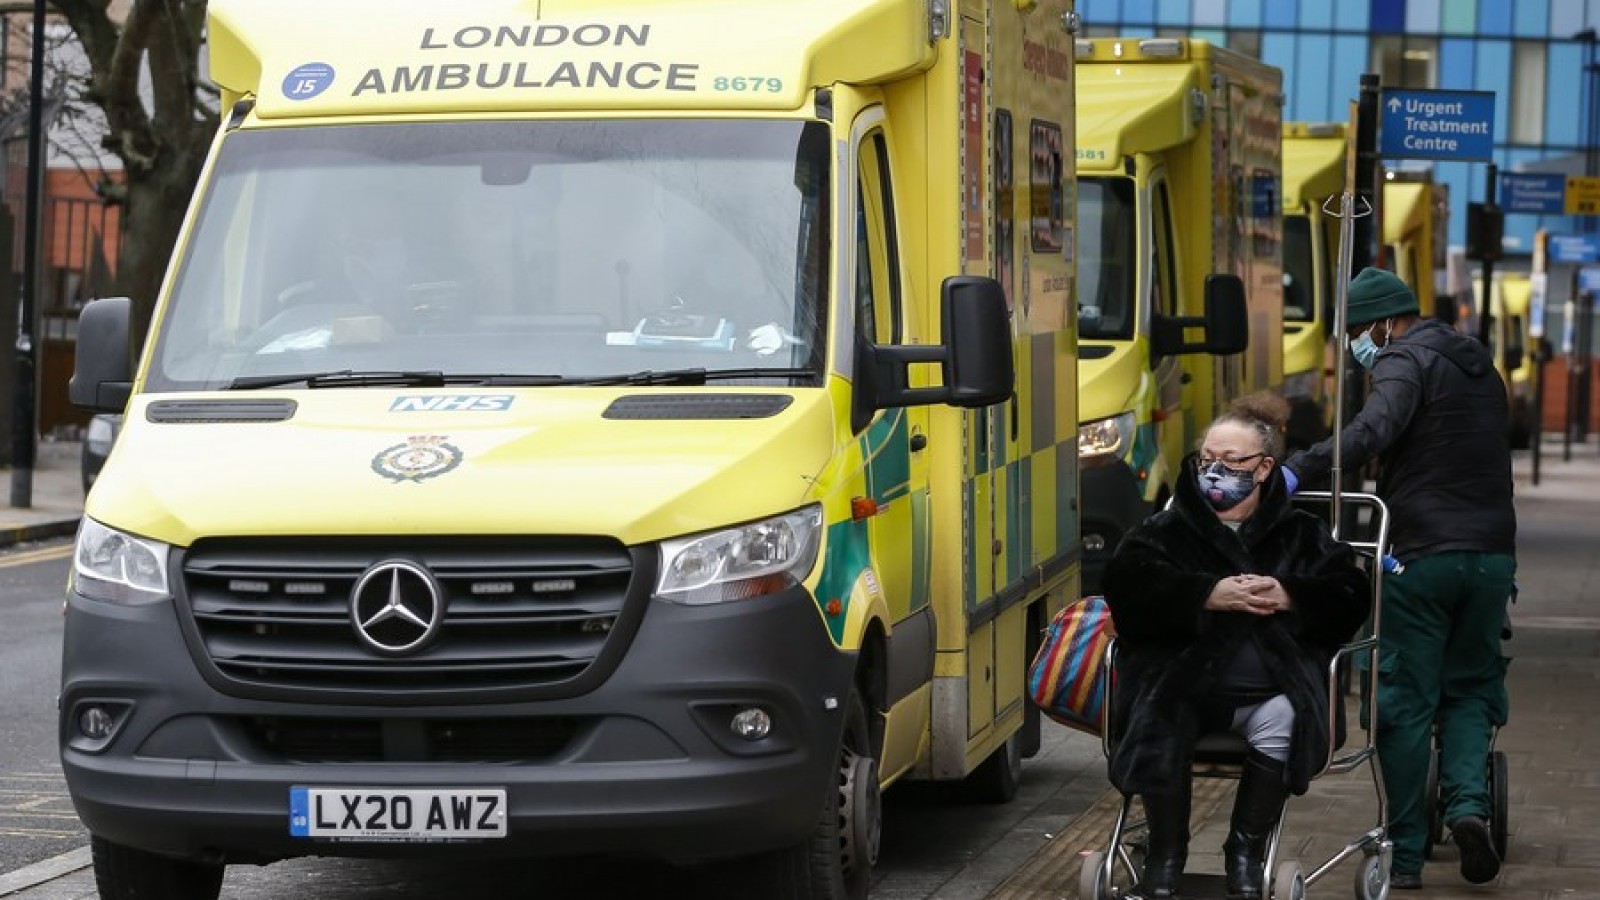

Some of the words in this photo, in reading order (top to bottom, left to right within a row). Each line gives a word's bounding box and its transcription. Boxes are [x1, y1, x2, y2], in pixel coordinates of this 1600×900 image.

[420, 24, 650, 49] LONDON
[351, 61, 699, 96] AMBULANCE
[712, 76, 783, 93] 8679
[1405, 99, 1463, 118] Urgent
[1405, 117, 1488, 134] Treatment
[1403, 134, 1458, 150] Centre
[390, 396, 514, 411] NHS
[315, 795, 412, 829] LX20
[426, 796, 499, 830] AWZ
